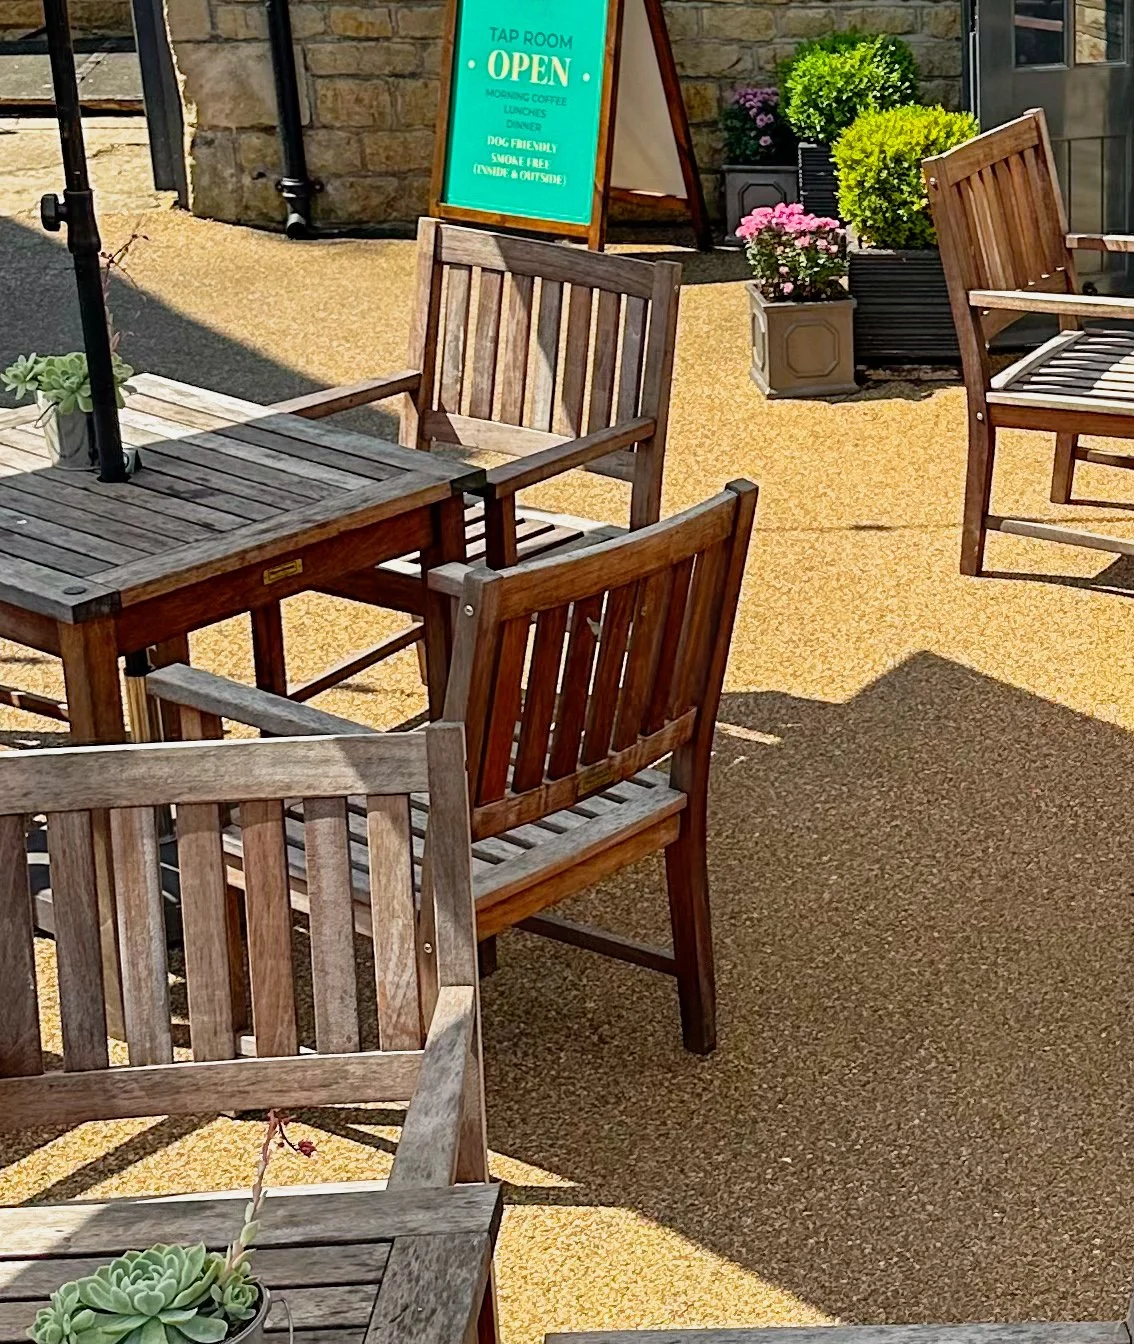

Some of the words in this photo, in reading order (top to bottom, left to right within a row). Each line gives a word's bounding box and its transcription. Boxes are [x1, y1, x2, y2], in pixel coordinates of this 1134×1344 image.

[489, 26, 519, 43] TAP
[523, 30, 573, 50] ROOM
[487, 49, 572, 88] OPEN
[484, 88, 530, 103] MORNING
[531, 93, 568, 107] COFFEE
[503, 104, 547, 119] LUNCHES
[505, 119, 542, 132] DINNER
[487, 135, 509, 147] DOG
[510, 138, 558, 154] FRIENDLY
[491, 152, 524, 167] SMOKE
[526, 157, 551, 170] FREE
